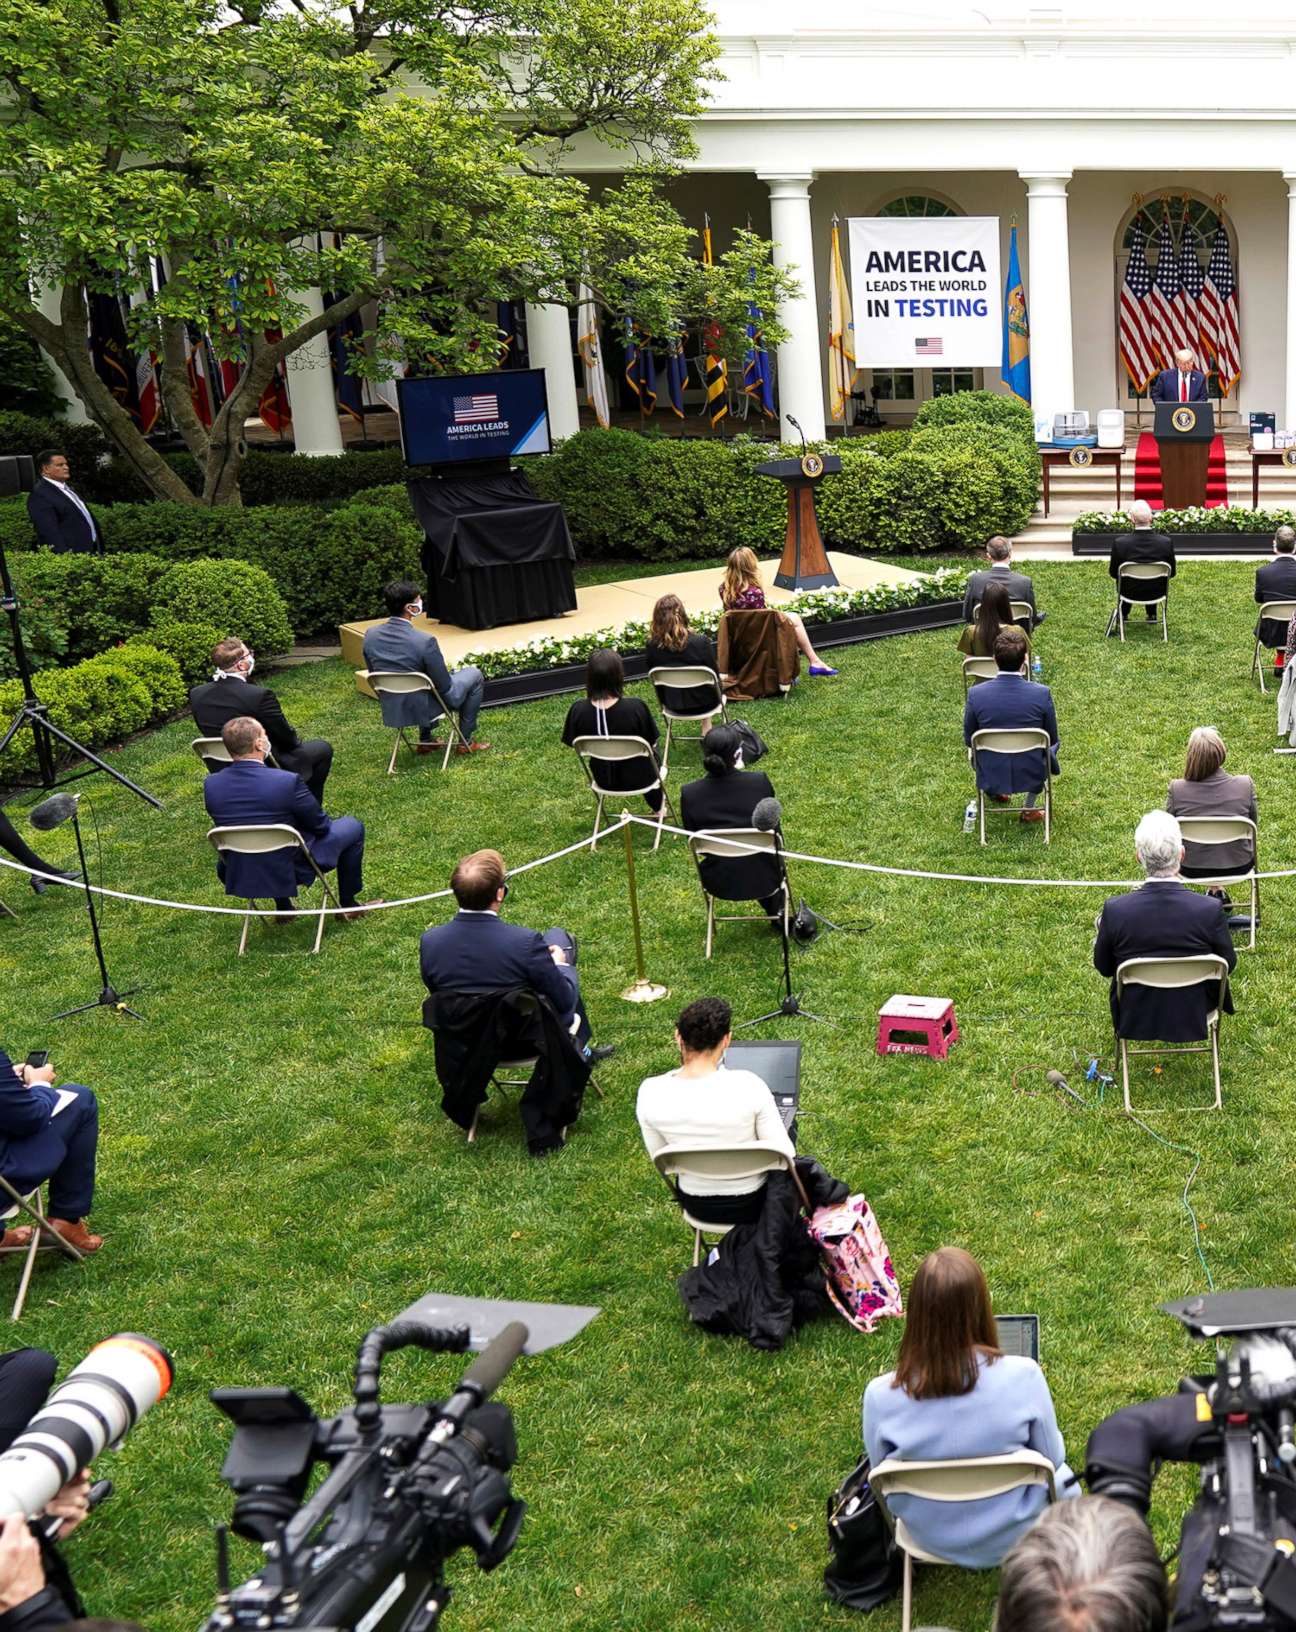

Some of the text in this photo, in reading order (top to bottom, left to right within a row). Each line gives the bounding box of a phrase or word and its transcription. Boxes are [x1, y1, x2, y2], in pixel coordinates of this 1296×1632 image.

[865, 250, 987, 273] AMERICA
[866, 280, 987, 292] LEADS THE WORLD
[867, 298, 988, 318] IN TESTING
[446, 421, 509, 434] AMERICA LEADS
[487, 430, 510, 438] TESTING
